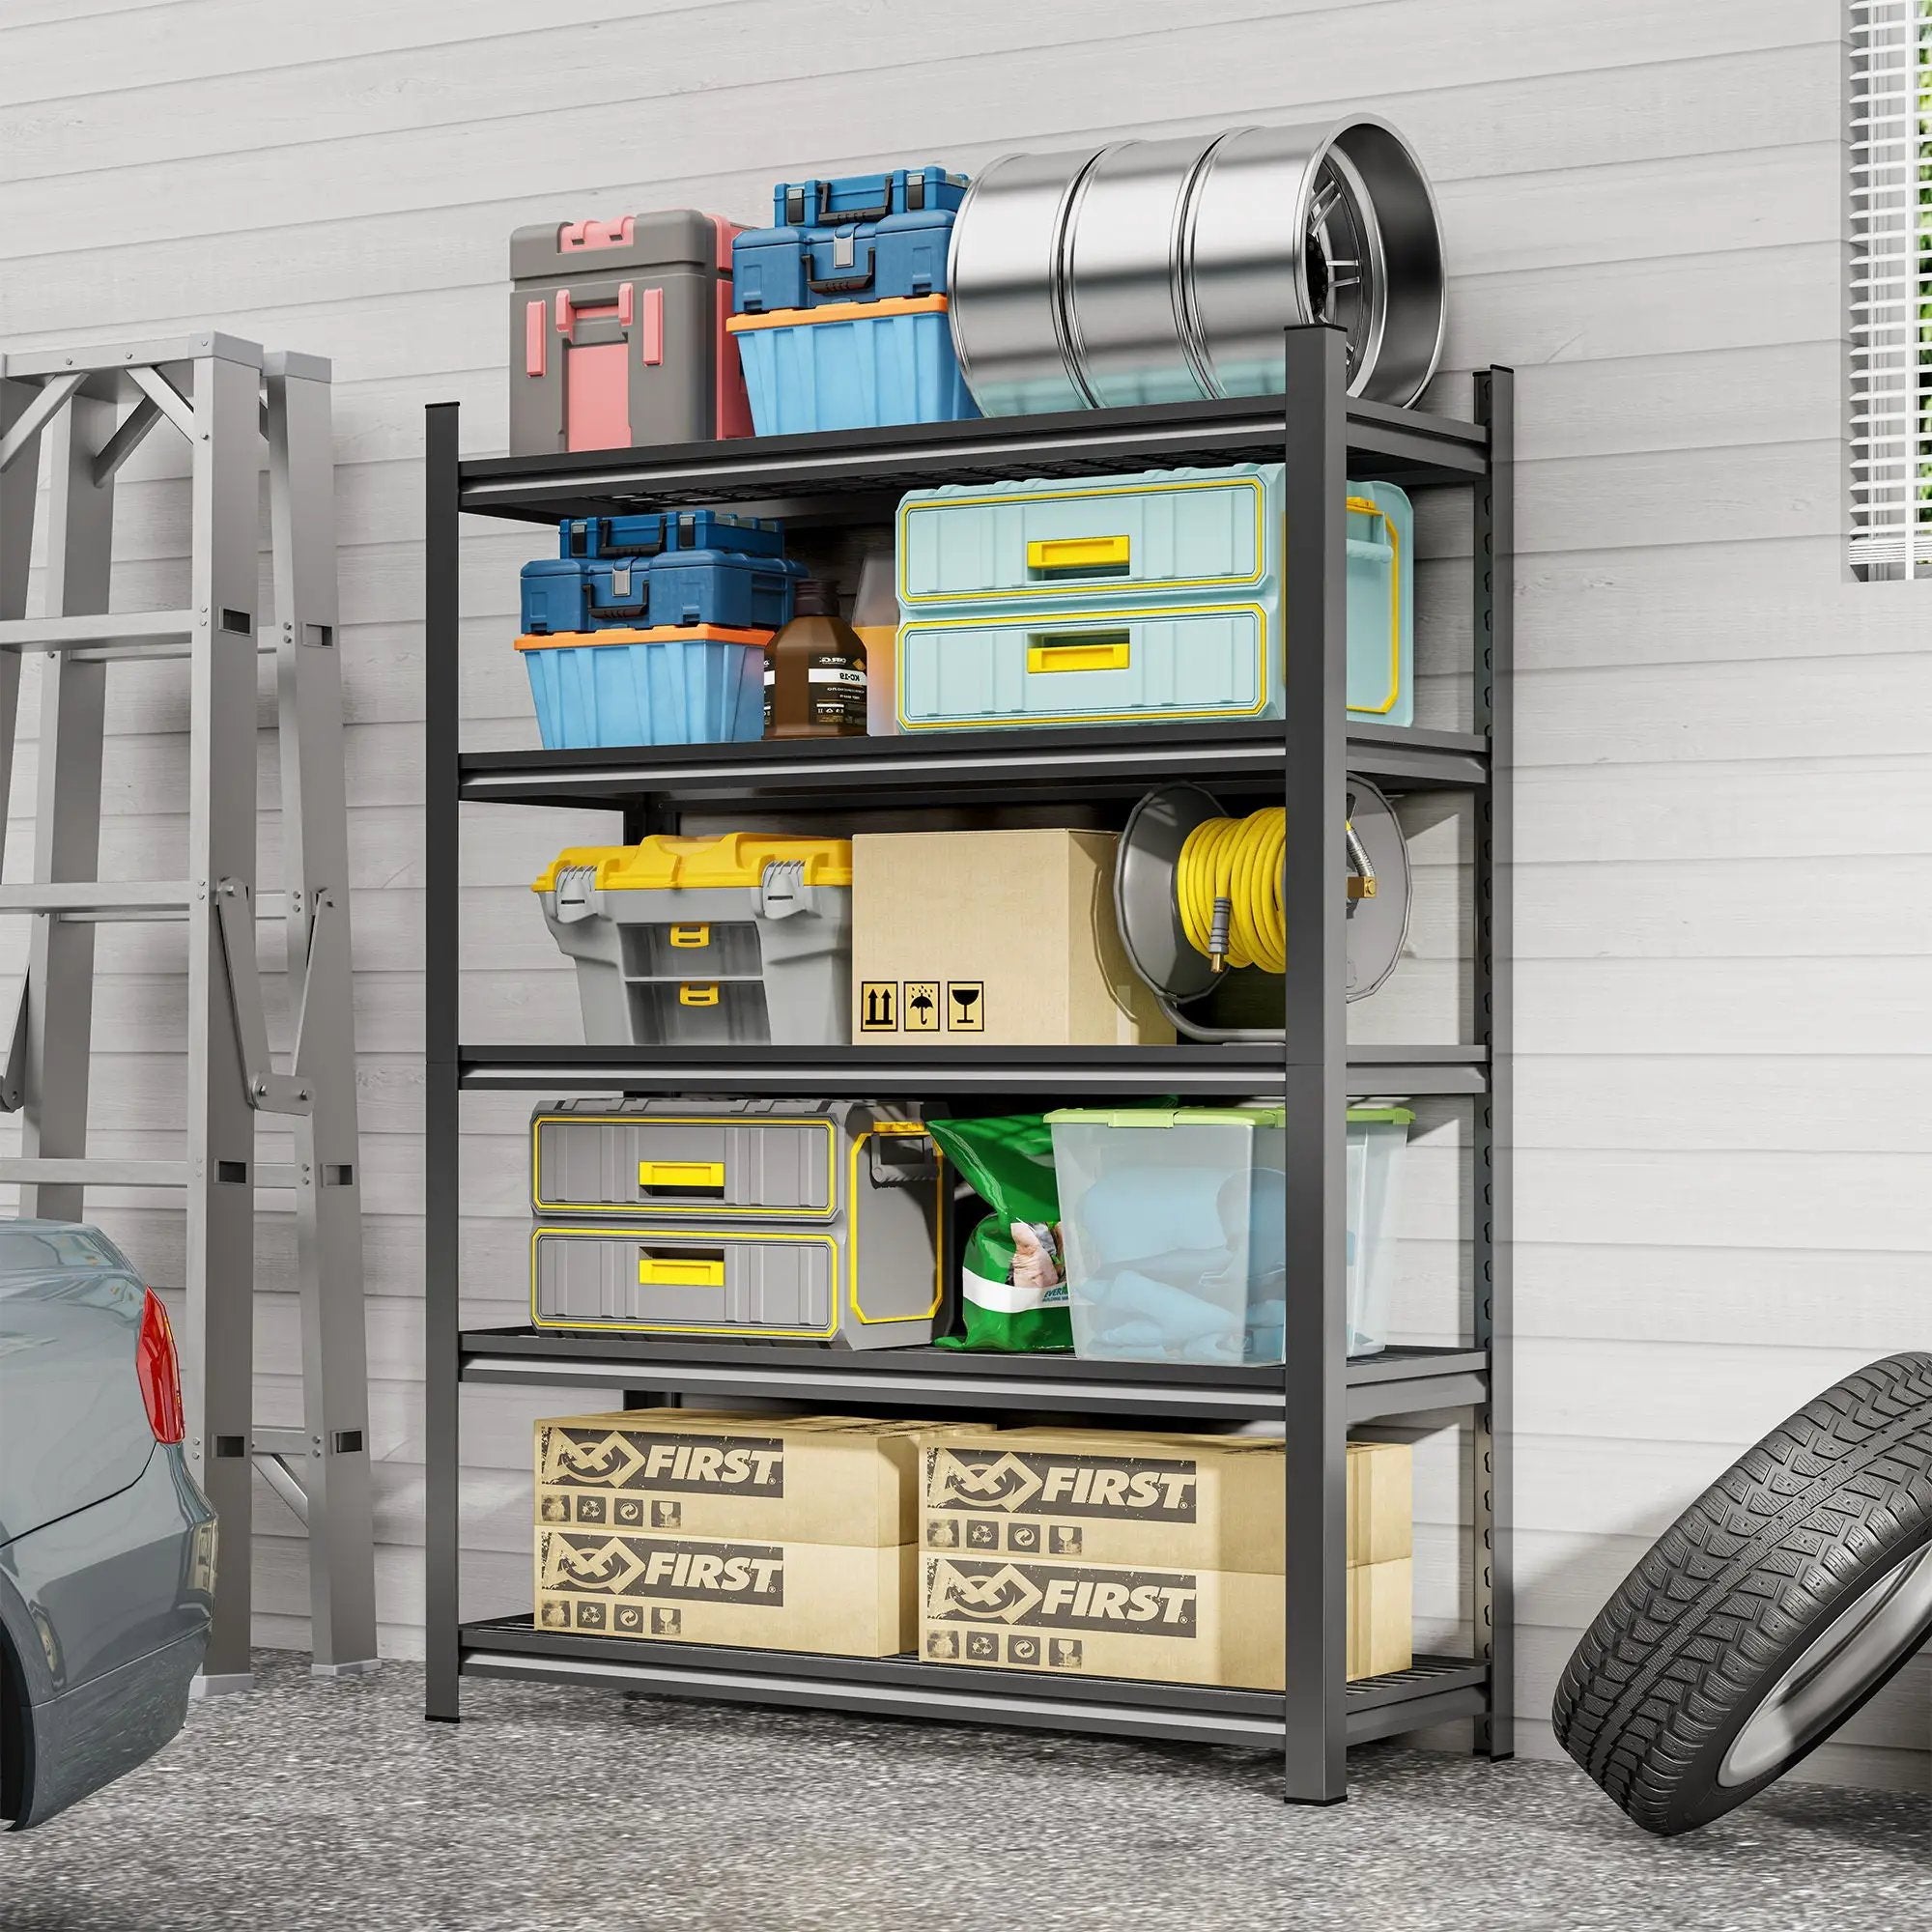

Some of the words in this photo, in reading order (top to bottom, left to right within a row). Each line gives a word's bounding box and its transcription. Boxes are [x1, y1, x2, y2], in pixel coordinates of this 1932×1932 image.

[644, 1445, 783, 1485] FIRST
[1041, 1467, 1196, 1509] FIRST
[644, 1551, 783, 1593] FIRST
[1041, 1579, 1196, 1624] FIRST
